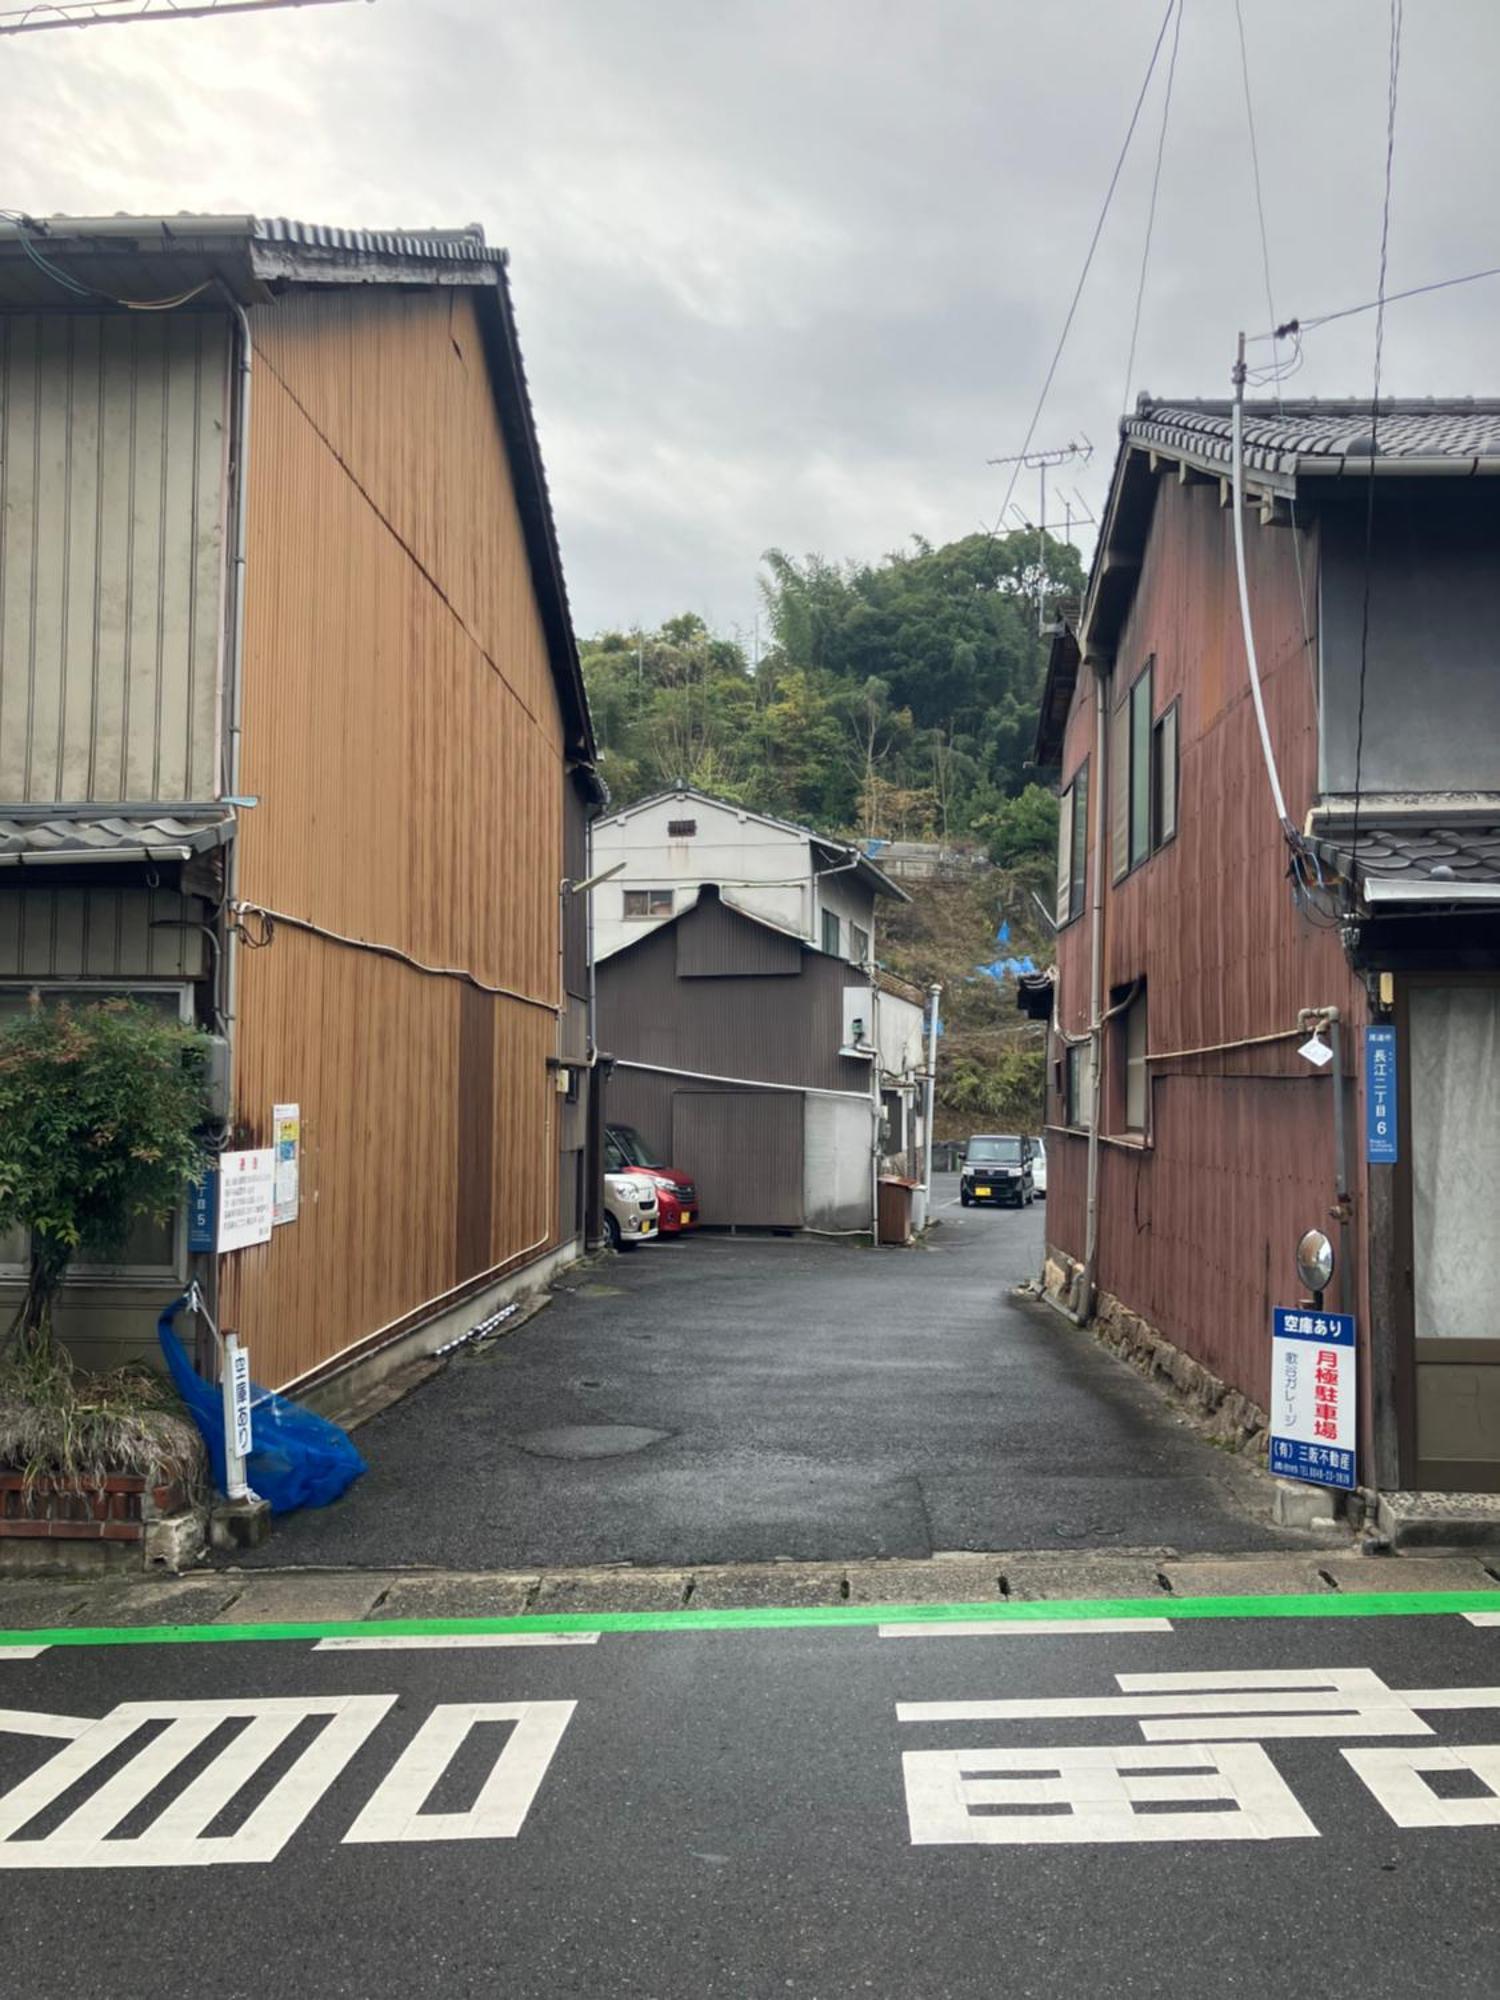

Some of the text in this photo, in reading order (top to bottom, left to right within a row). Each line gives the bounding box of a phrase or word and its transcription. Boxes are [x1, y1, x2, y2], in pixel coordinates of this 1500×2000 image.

[1283, 1314, 1341, 1337] 空庫あり
[1314, 1350, 1339, 1440] 月極駐車場
